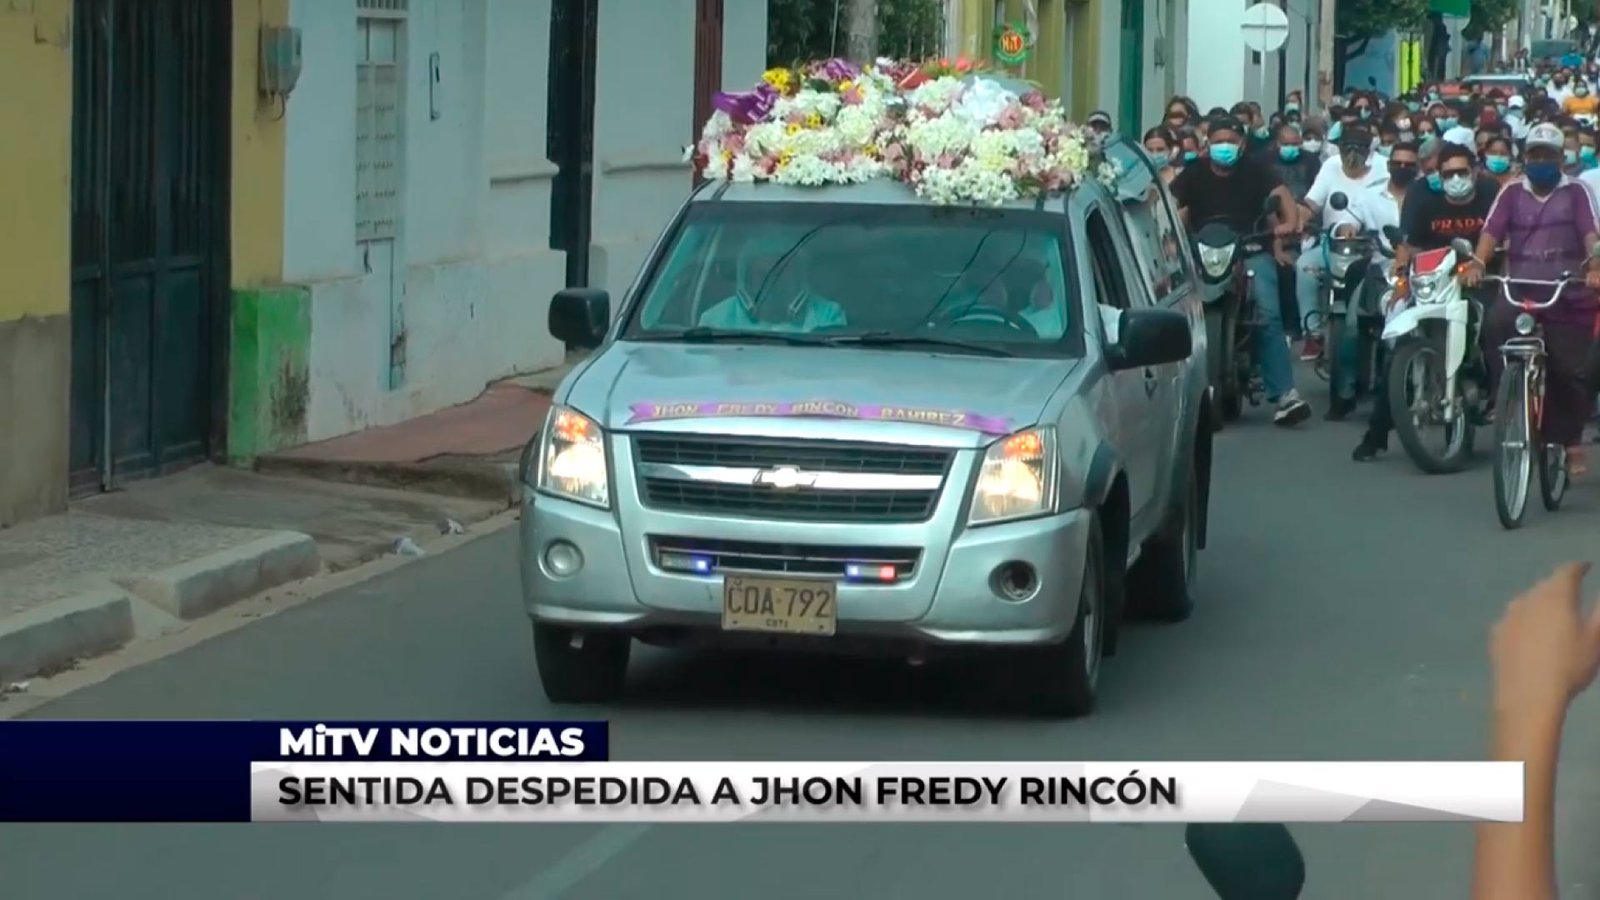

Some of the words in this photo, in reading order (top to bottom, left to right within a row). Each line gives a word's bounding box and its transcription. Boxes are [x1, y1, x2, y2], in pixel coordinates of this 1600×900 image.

[1431, 218, 1485, 231] PRADA
[653, 404, 698, 417] JHON
[881, 407, 966, 426] RAMIREZ
